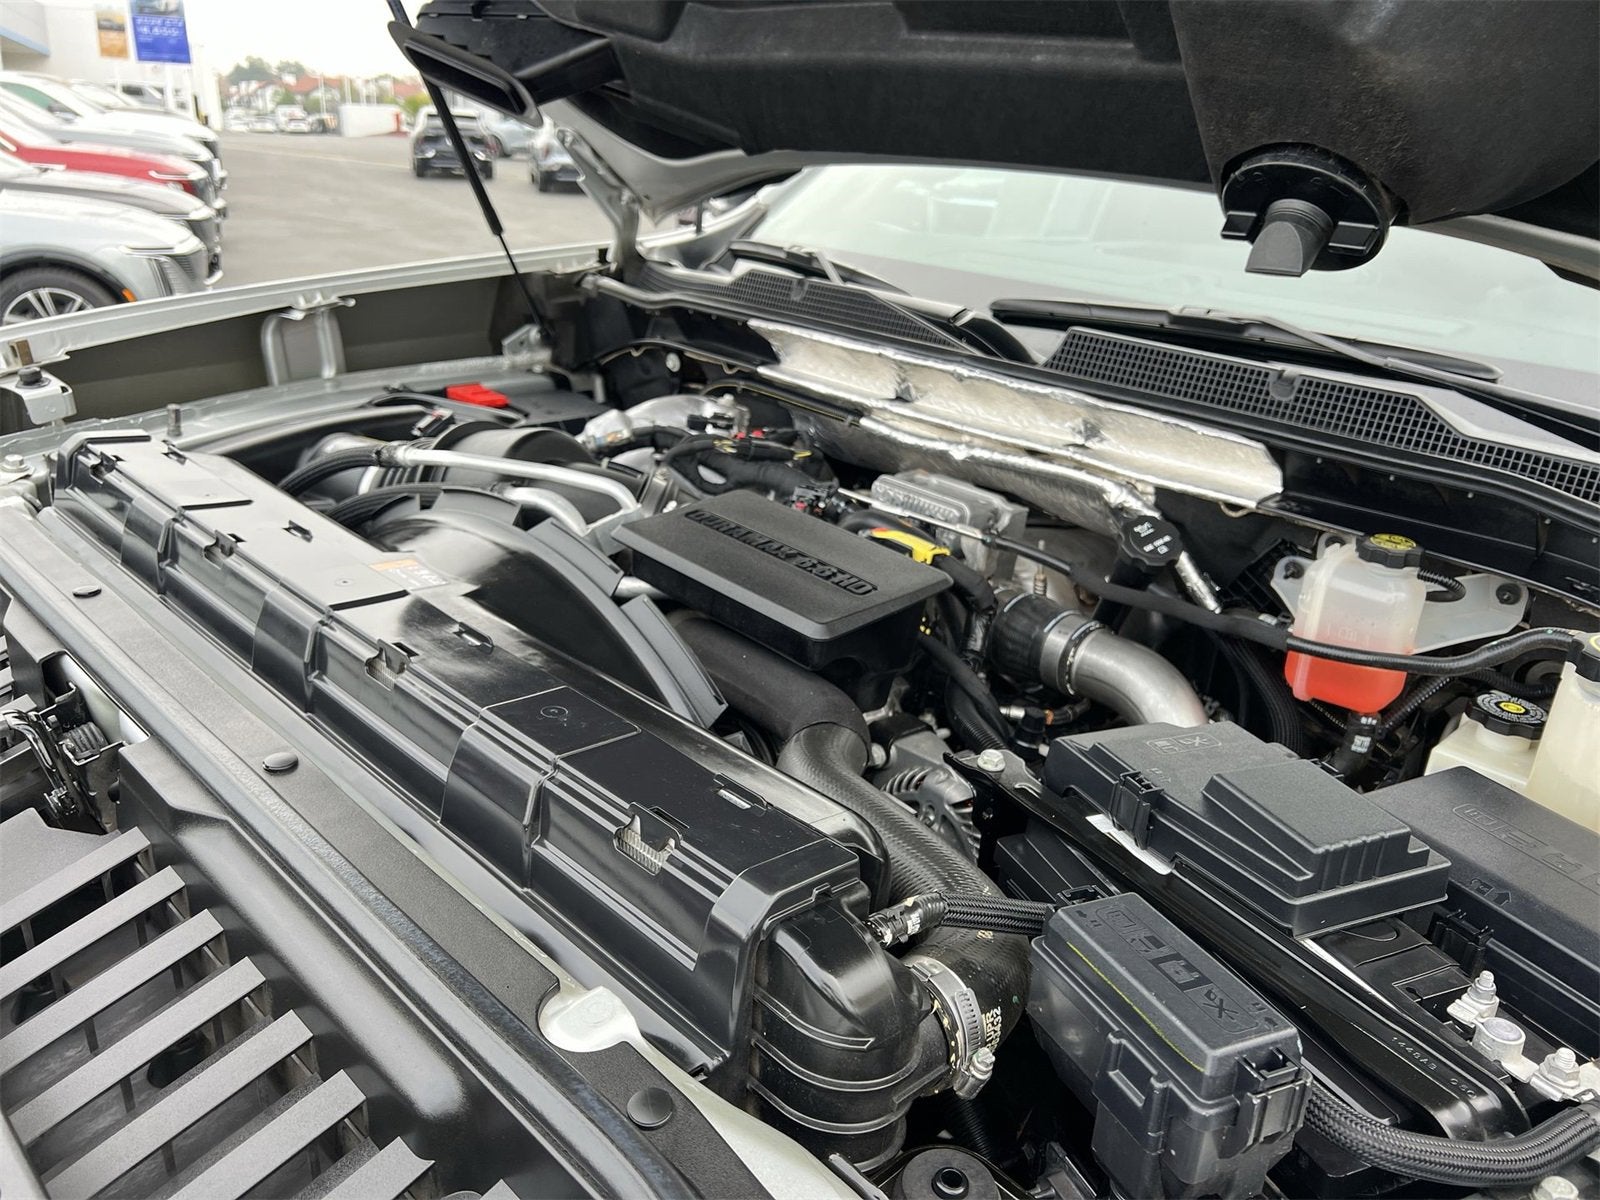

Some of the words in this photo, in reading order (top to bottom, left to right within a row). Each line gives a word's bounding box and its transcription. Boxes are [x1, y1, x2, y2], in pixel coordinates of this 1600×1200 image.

[685, 510, 798, 560] DURAMAX
[795, 552, 839, 581] 6.6
[831, 567, 878, 595] HD
